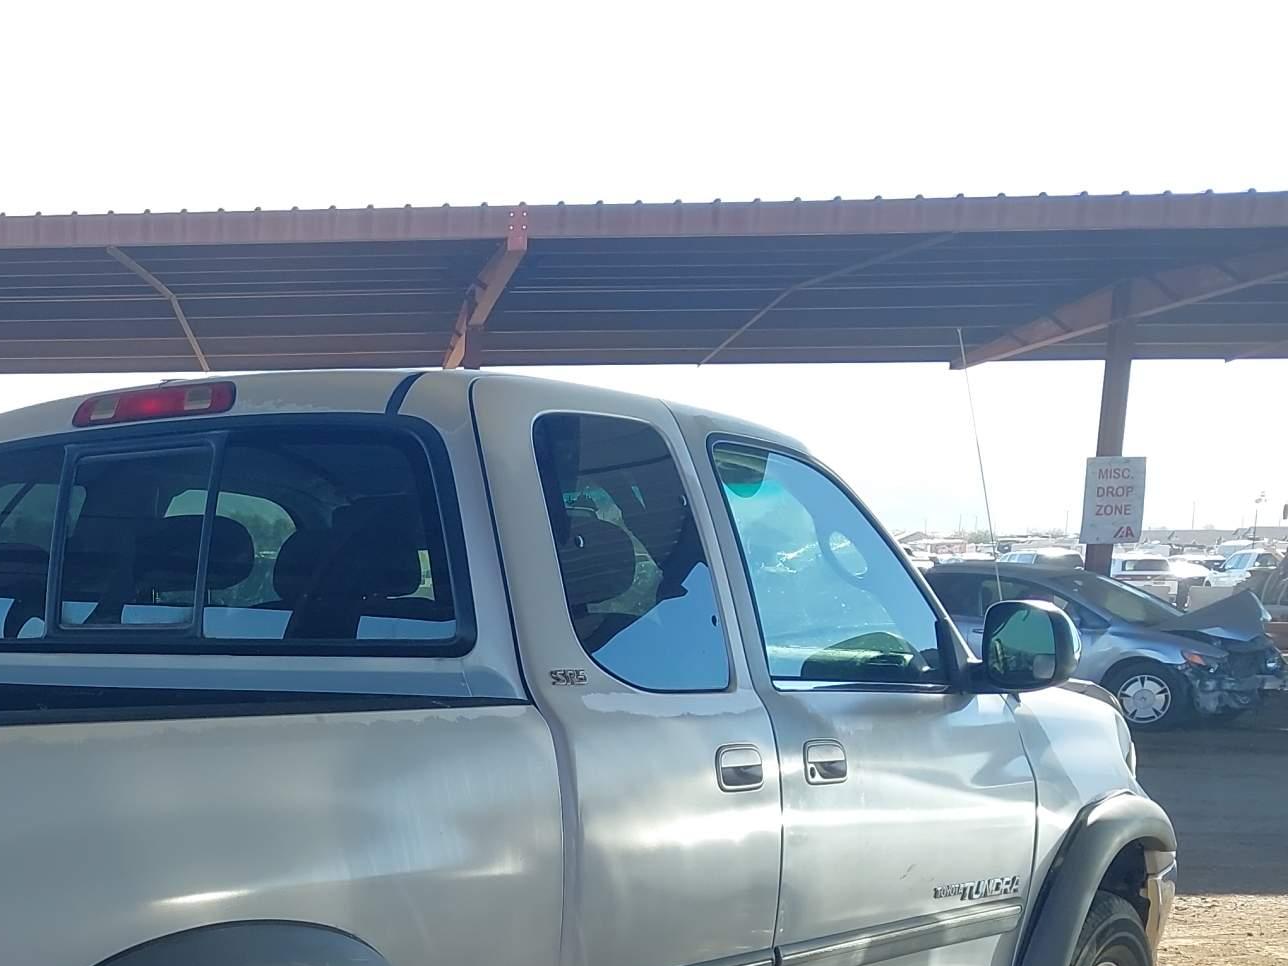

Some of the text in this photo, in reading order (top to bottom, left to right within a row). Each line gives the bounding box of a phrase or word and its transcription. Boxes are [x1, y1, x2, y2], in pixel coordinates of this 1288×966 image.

[1097, 467, 1134, 480] MISC.
[1096, 486, 1134, 498] DROP
[1095, 504, 1132, 516] ZONE
[960, 876, 1020, 901] TUNDRA
